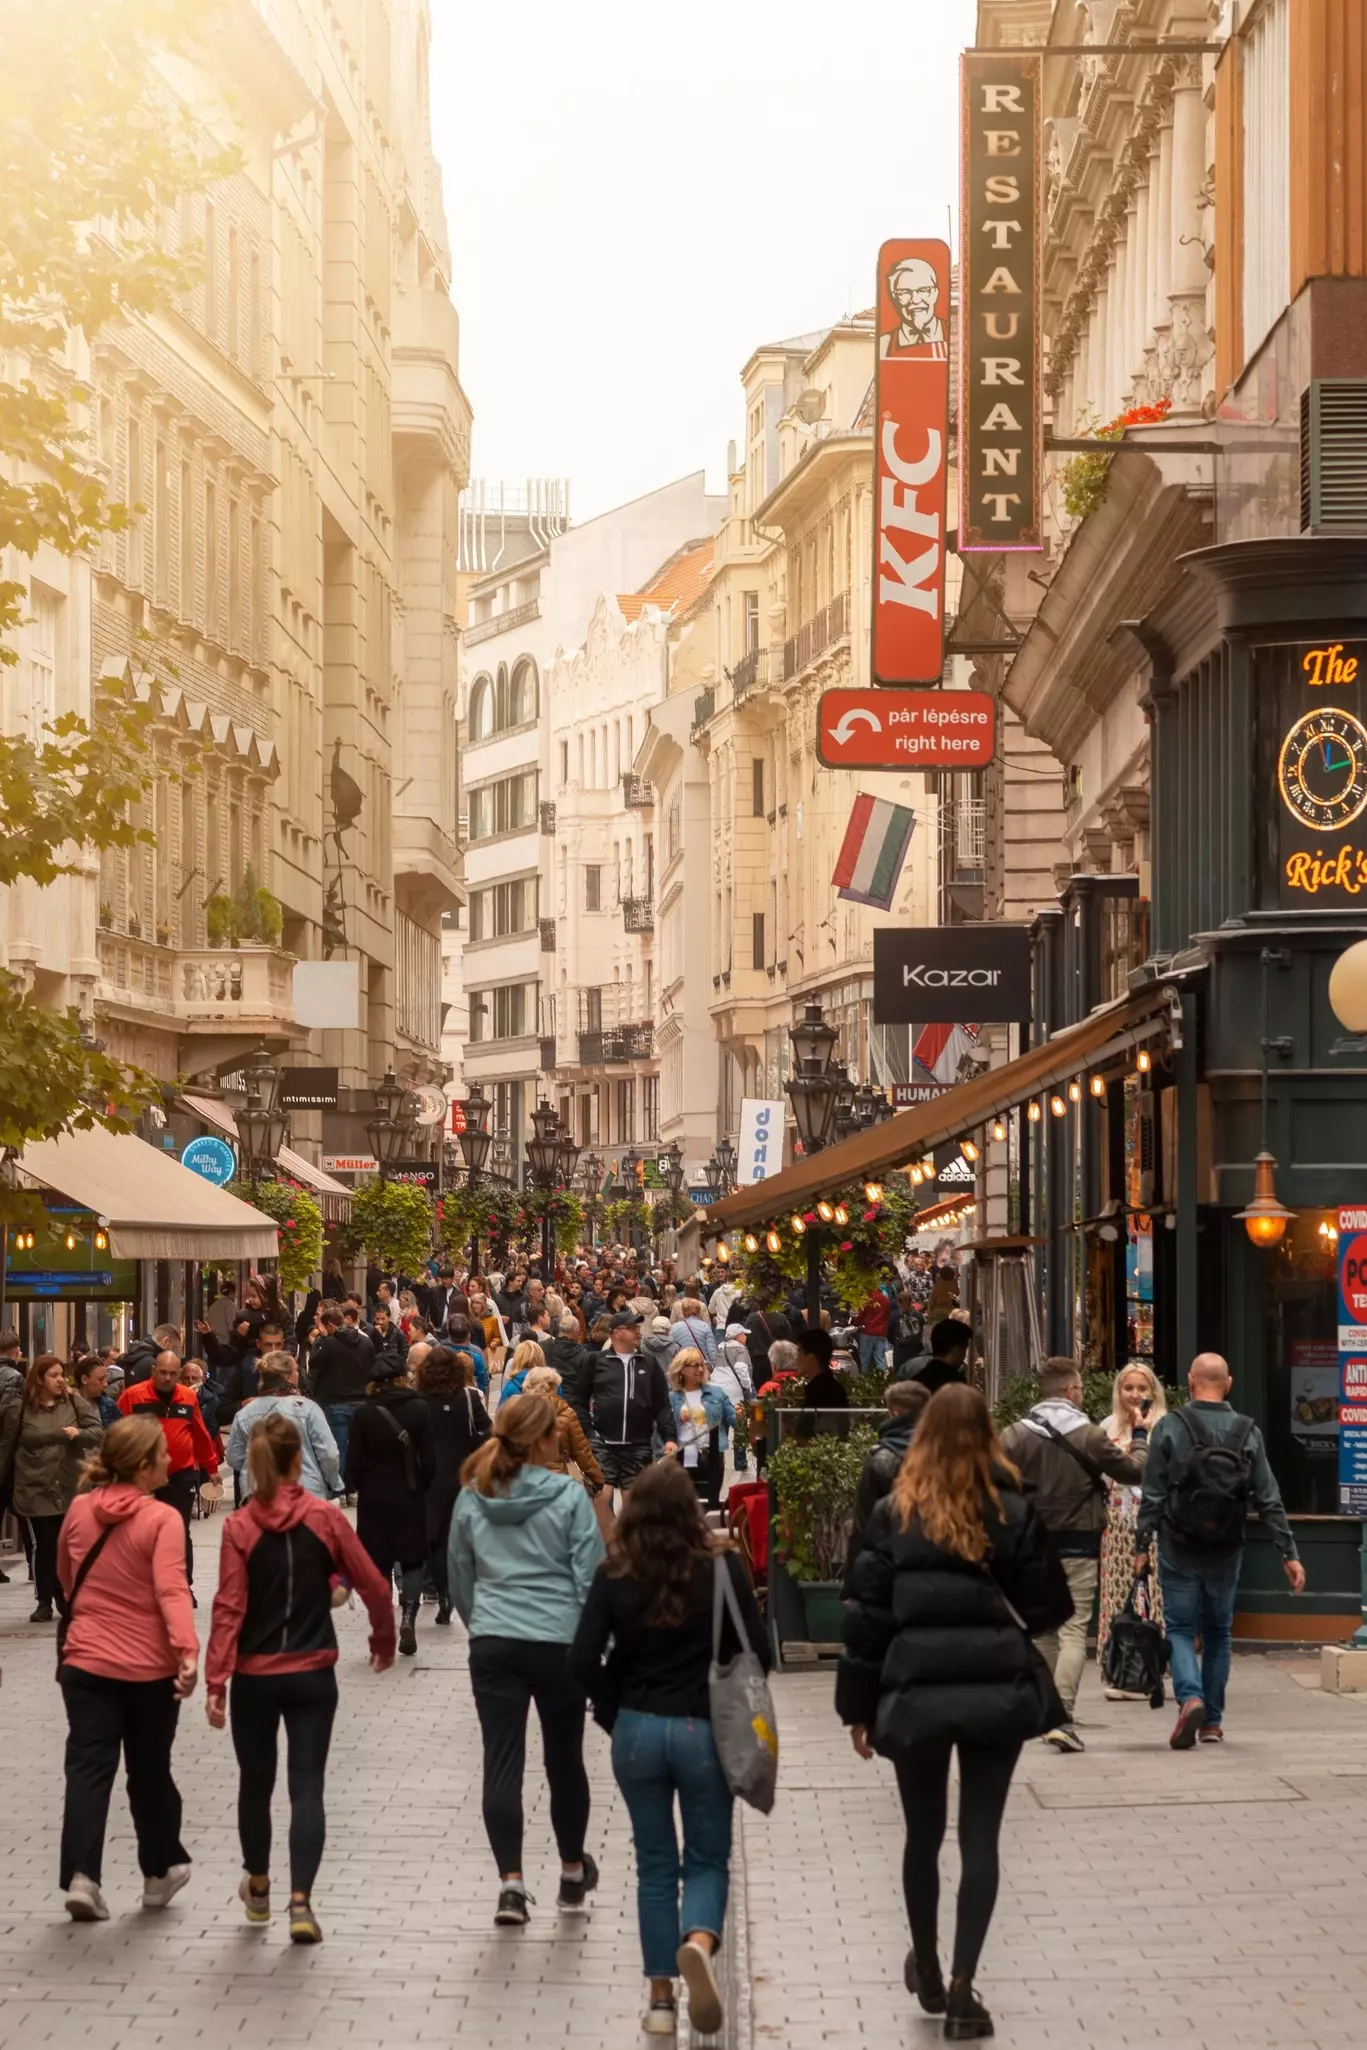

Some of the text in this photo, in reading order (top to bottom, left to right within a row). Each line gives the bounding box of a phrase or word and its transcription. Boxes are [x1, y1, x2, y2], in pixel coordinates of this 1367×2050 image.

[980, 84, 1025, 521] RESTAURANT
[879, 420, 942, 620] KFC
[1303, 644, 1358, 686] The
[888, 708, 988, 727] pár lépésre
[895, 735, 980, 753] right here
[903, 965, 1002, 986] Kazar
[191, 1154, 217, 1166] Milky
[335, 1160, 376, 1169] Müller
[201, 1163, 222, 1176] Way
[938, 1172, 976, 1182] adidas
[690, 1192, 716, 1204] CHAN
